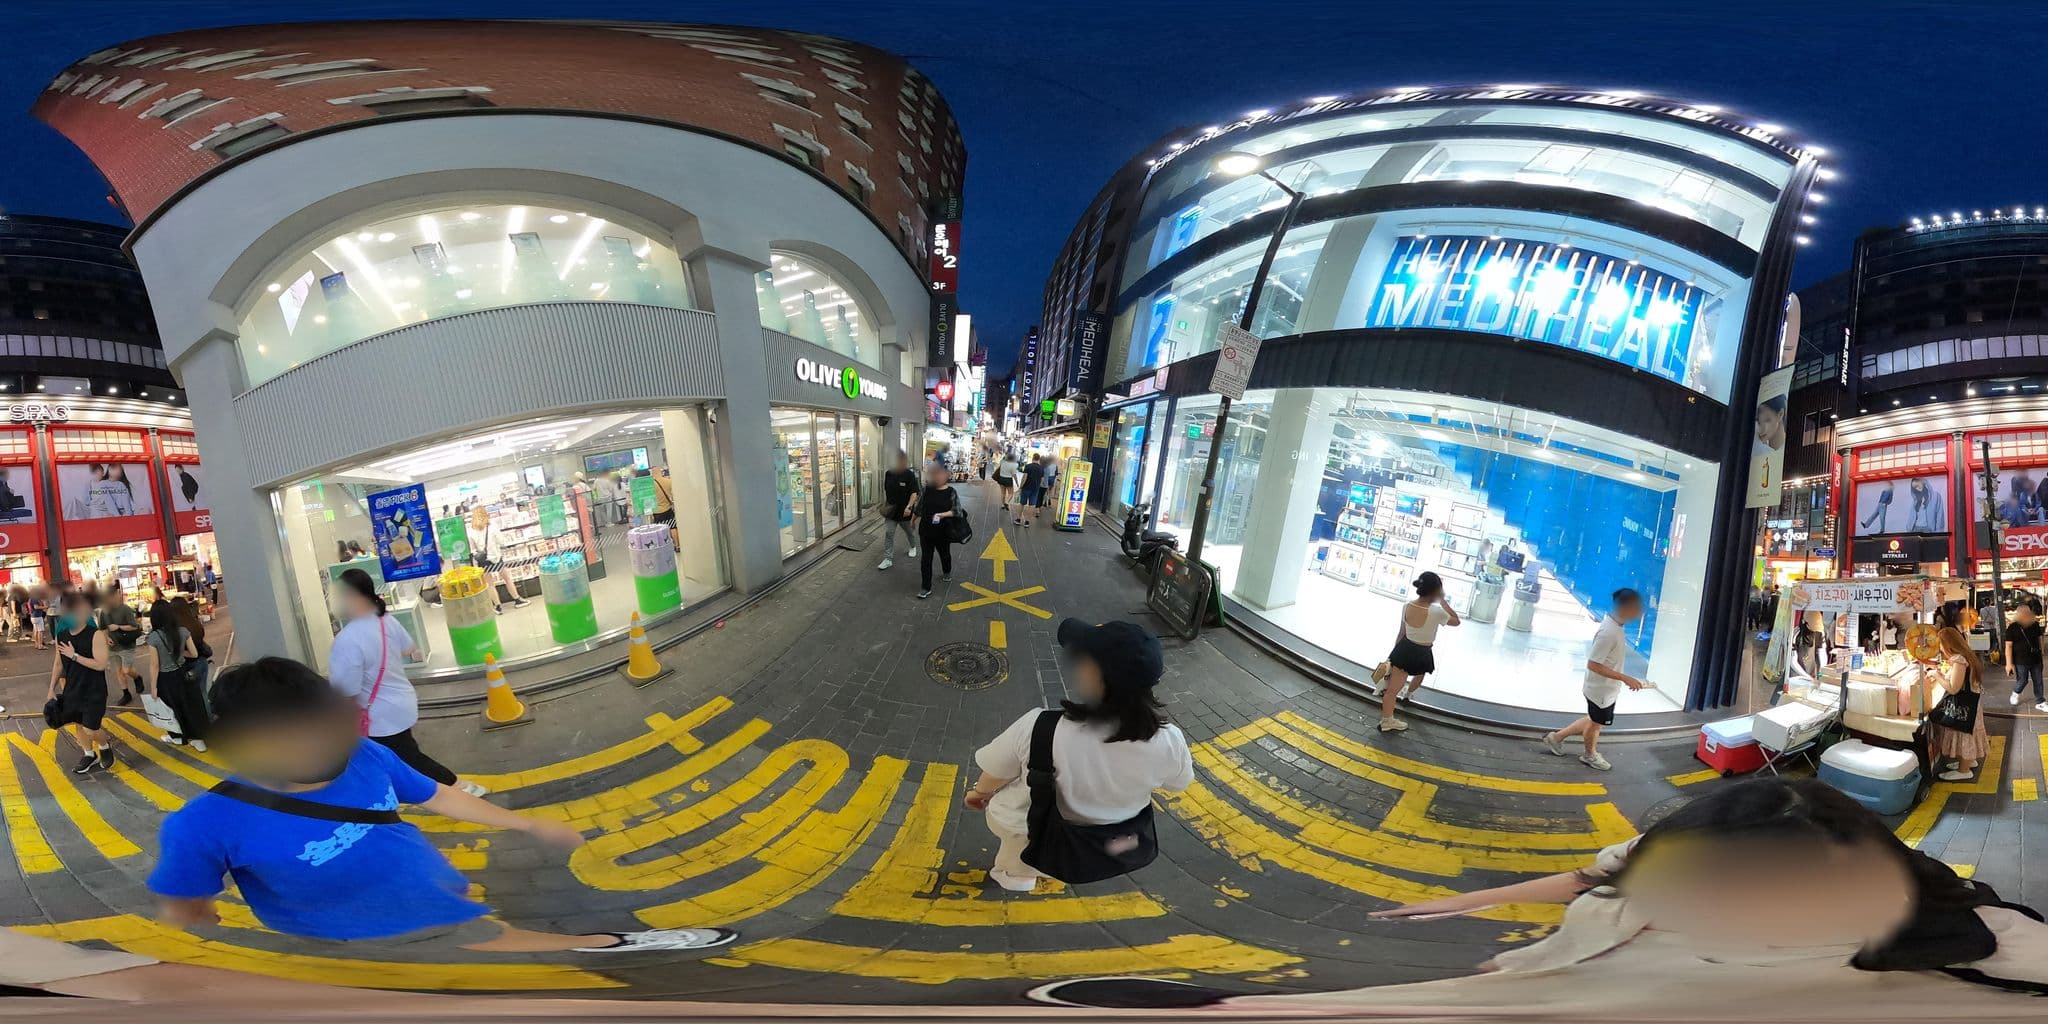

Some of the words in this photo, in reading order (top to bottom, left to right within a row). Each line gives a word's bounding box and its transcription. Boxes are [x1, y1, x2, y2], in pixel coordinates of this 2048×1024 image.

[932, 281, 947, 290] 3F
[939, 303, 947, 323] OLIVE
[1376, 283, 1676, 379] MEDIHEAL
[938, 332, 946, 356] YOUNG
[1027, 334, 1037, 365] HOTEL
[1076, 319, 1098, 383] MEDIHEAL
[797, 358, 842, 389] OLIVE
[858, 376, 888, 401] YOUNG
[1023, 371, 1034, 404] SAVOY
[9, 403, 69, 421] SPAO
[1073, 477, 1084, 489] 元
[1071, 503, 1079, 513] $
